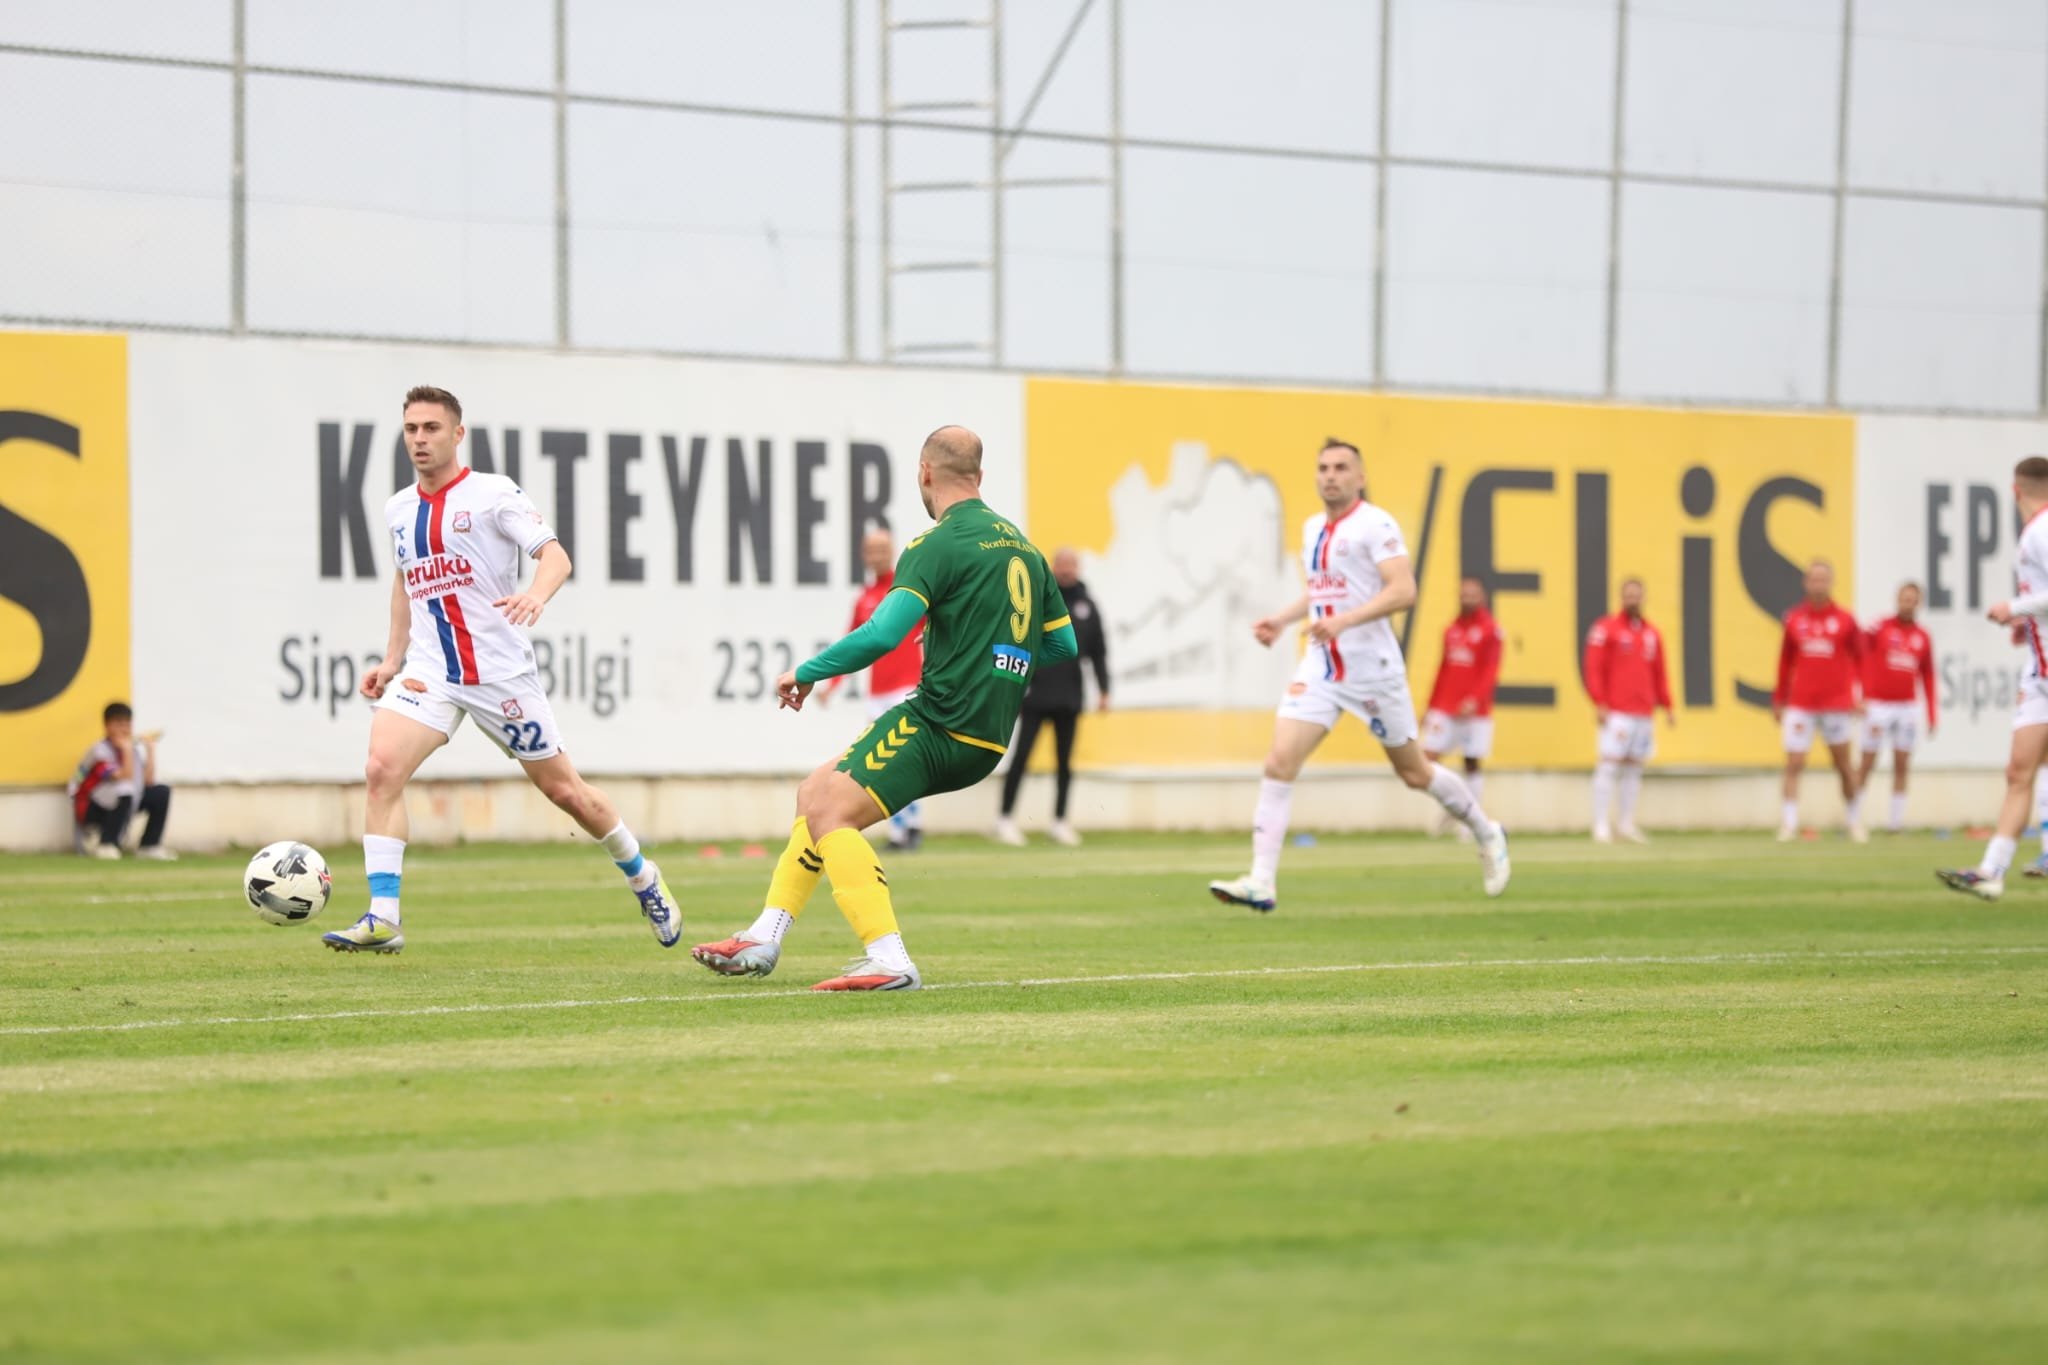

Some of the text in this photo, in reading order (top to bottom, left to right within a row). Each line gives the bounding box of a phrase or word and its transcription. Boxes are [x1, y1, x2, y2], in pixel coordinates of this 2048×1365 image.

[317, 420, 893, 584] KTEYNER
[407, 554, 472, 586] erülkü
[1927, 484, 2021, 609] EP
[411, 576, 474, 600] supermarket
[1007, 556, 1032, 644] 9
[503, 720, 549, 751] 22
